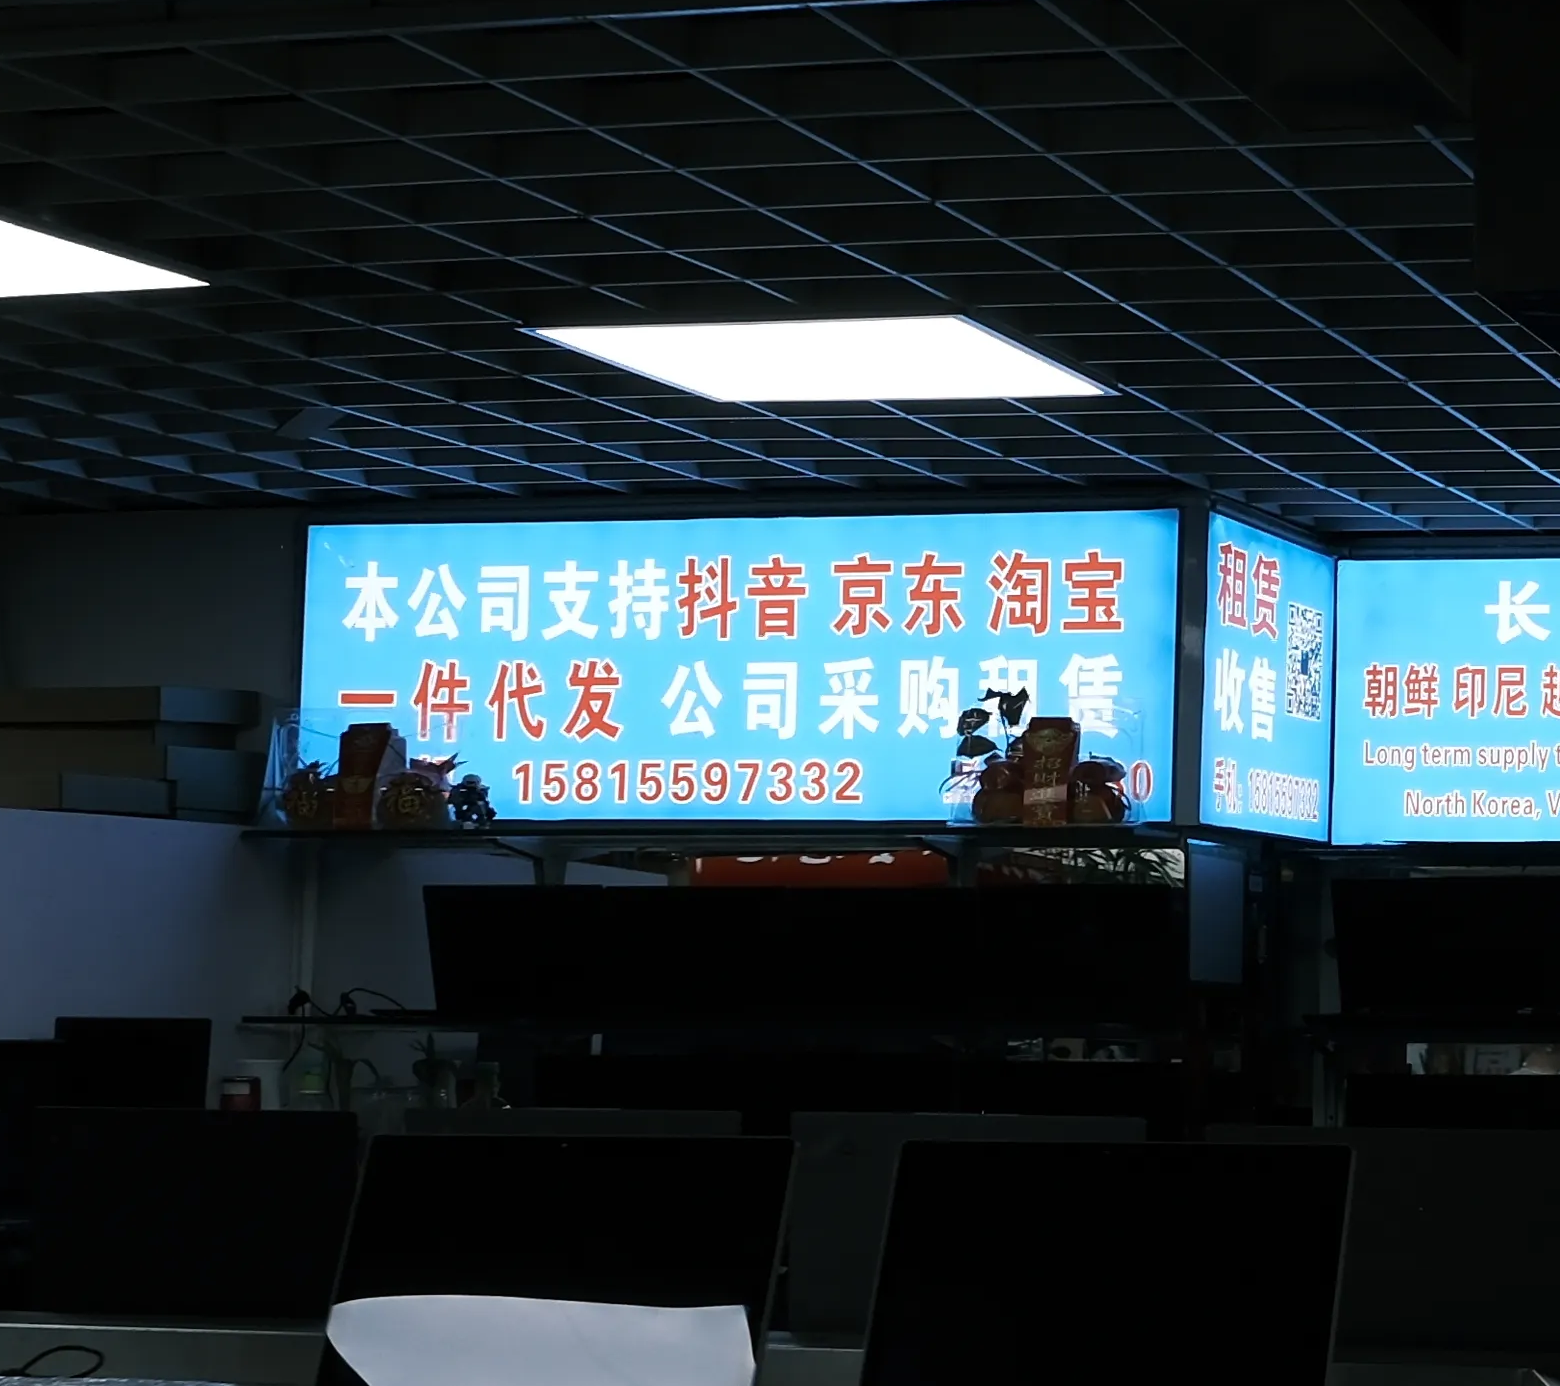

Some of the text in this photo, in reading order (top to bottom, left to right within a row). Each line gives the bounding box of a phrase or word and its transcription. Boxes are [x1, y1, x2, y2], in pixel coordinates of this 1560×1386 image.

[342, 548, 1127, 643] 本公司支持抖音 京东 淘宝
[1214, 539, 1282, 642] 租赁
[338, 657, 623, 744] 一件代发
[1213, 644, 1280, 745] 收售
[1362, 663, 1440, 719] 朝鲜
[1453, 663, 1529, 719] 印尼
[512, 758, 864, 805] 15815597332
[1362, 740, 1418, 772] Long
[1420, 740, 1471, 772] term
[1475, 740, 1550, 772] supply
[1246, 766, 1322, 825] 15815597332
[1403, 787, 1467, 823] North
[1470, 787, 1542, 823] Korea,
